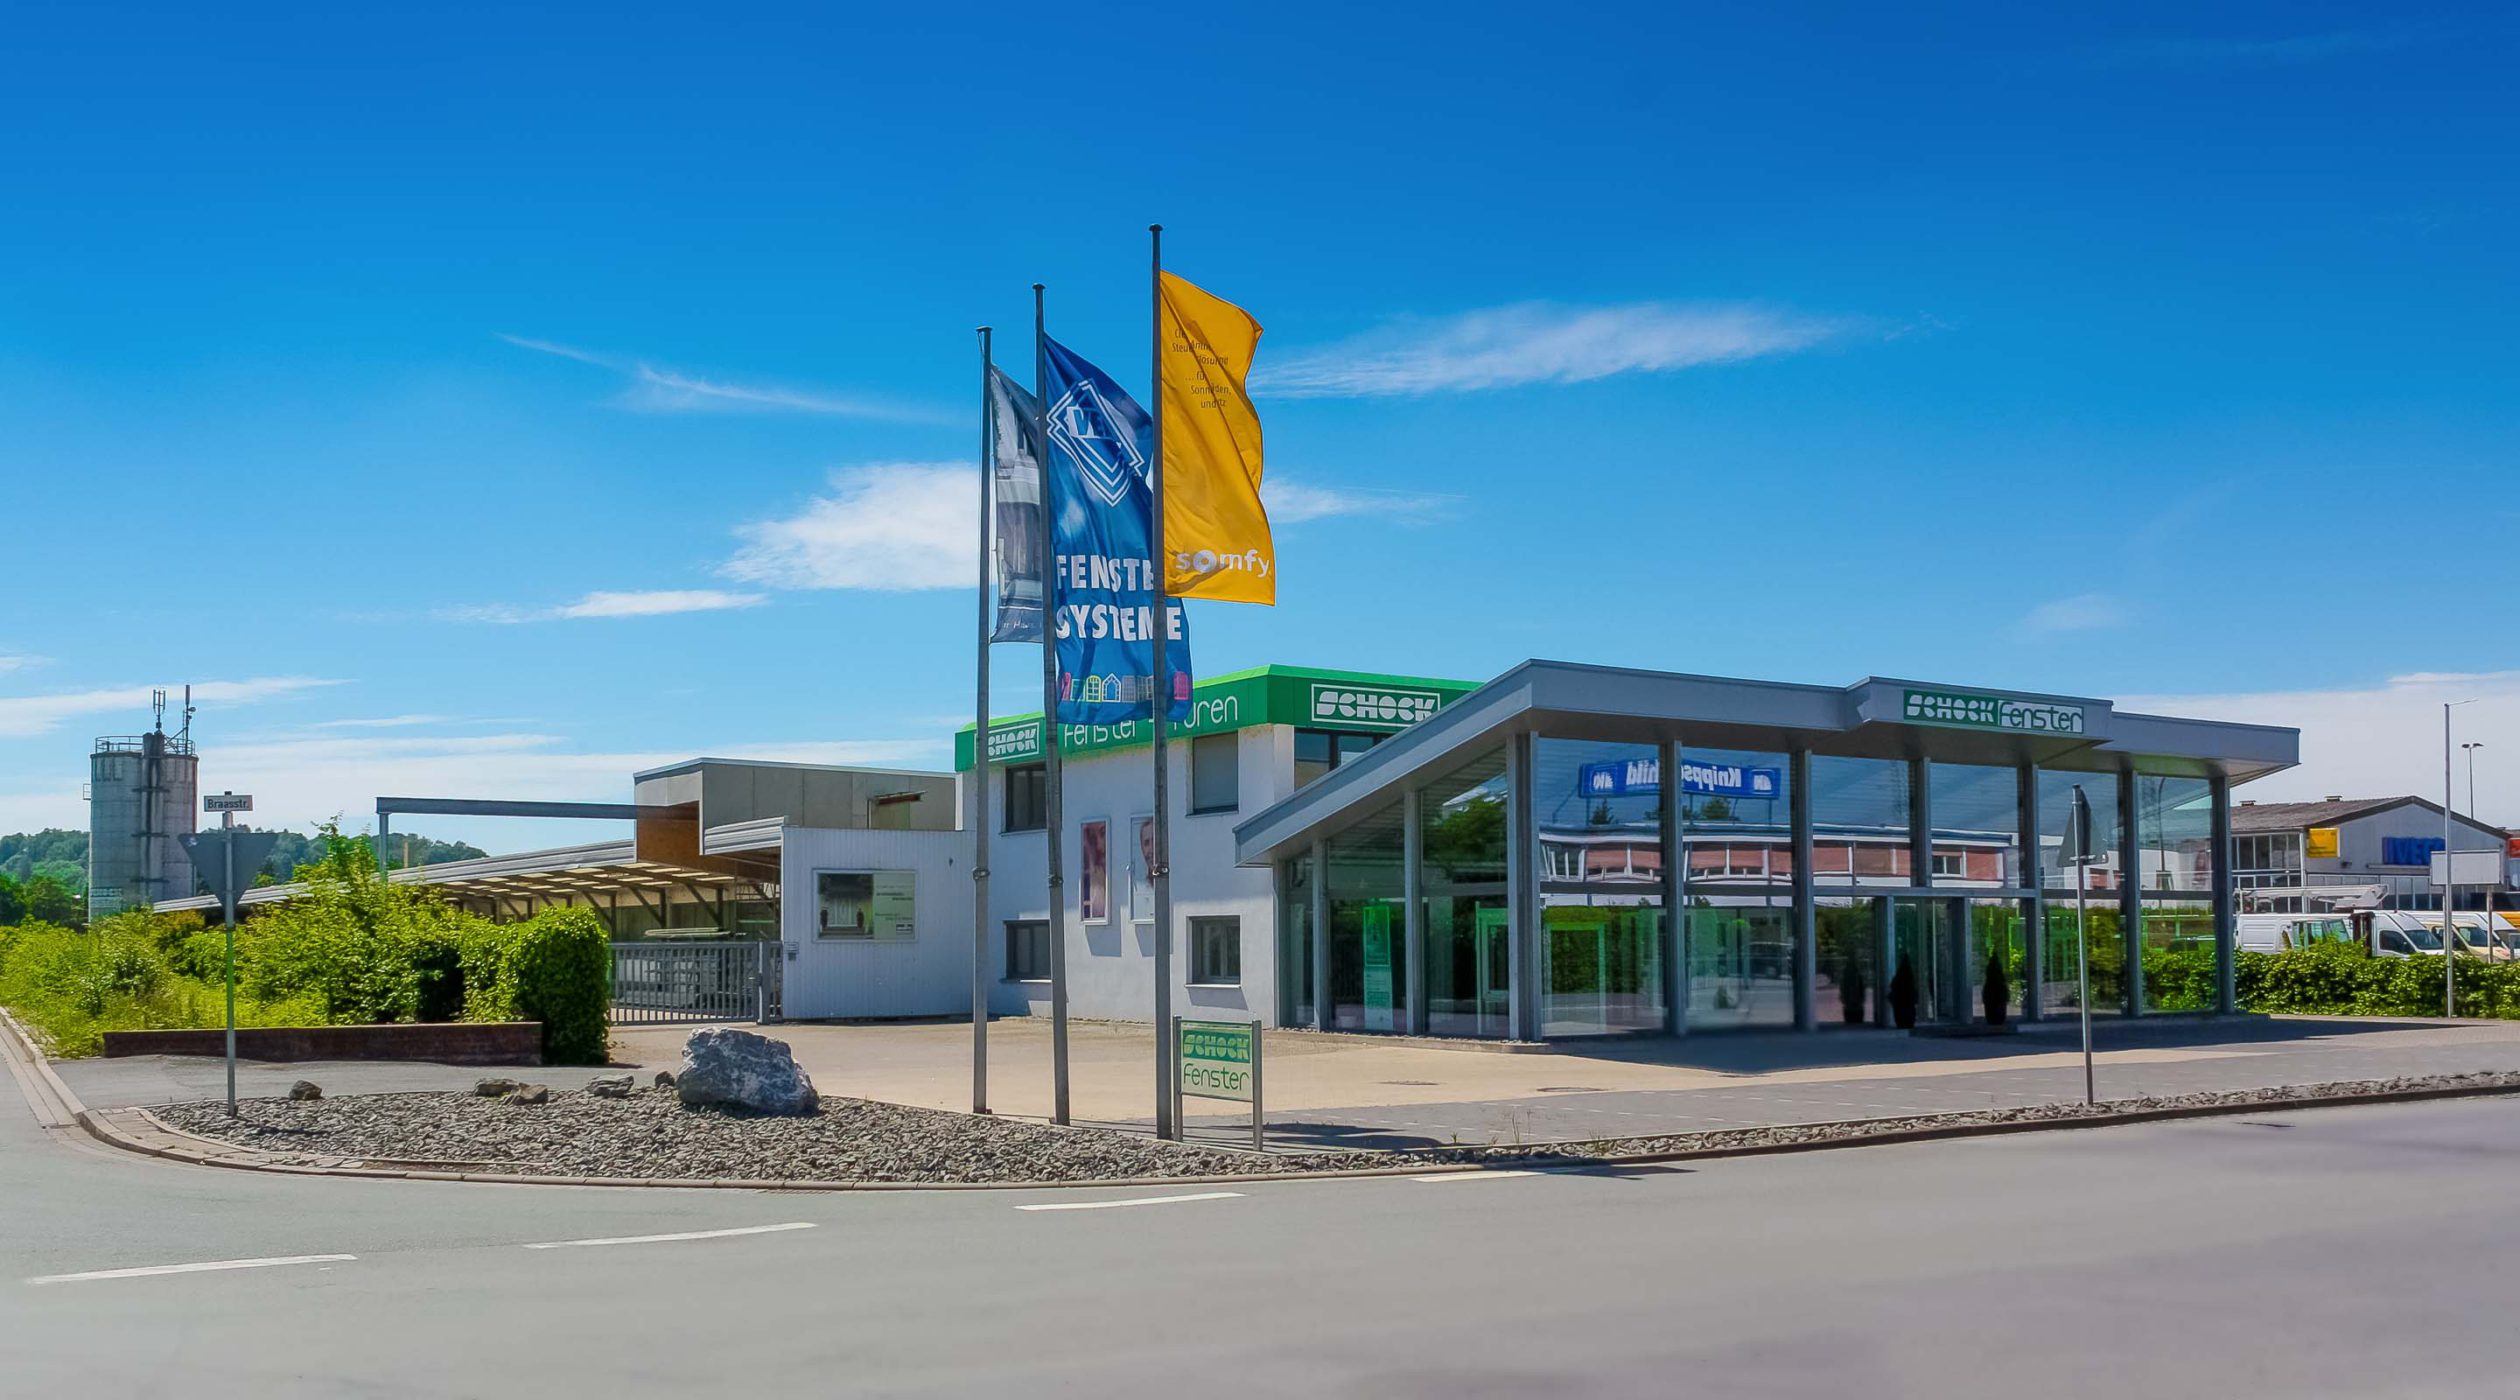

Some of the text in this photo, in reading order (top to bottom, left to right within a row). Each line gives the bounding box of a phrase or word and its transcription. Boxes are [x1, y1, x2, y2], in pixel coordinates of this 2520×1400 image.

[1056, 554, 1154, 592] FENSTE
[1176, 549, 1270, 578] somfy
[1056, 604, 1182, 641] SYSTEME
[1317, 691, 1435, 721] SCHOCK
[1907, 695, 2082, 731] SCHOCK Fenster
[988, 729, 1036, 757] CHOCK
[207, 799, 249, 809] Braasstr.
[1183, 1034, 1250, 1060] SCHOCK
[1183, 1063, 1250, 1091] Fenster
